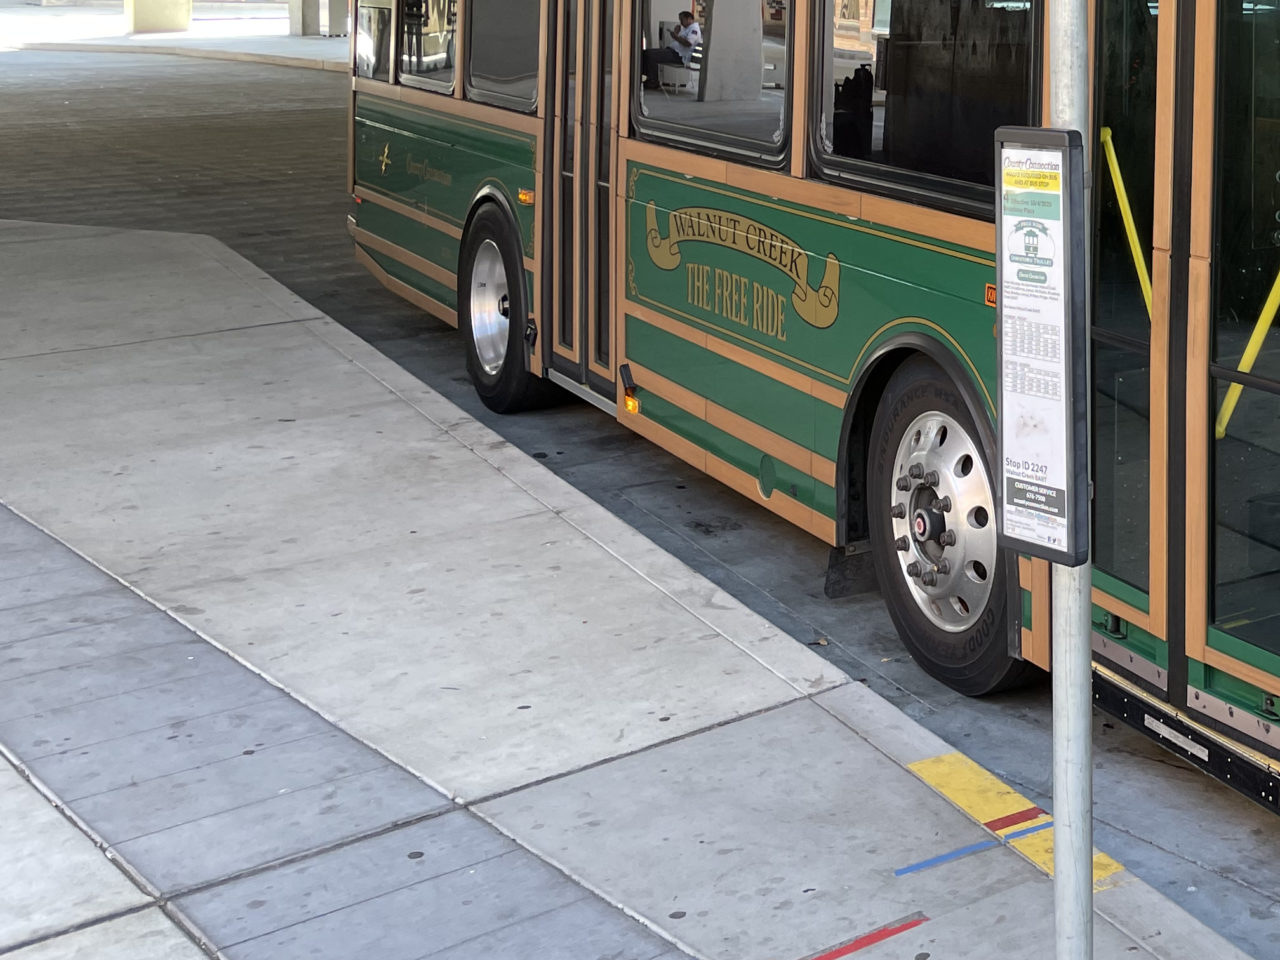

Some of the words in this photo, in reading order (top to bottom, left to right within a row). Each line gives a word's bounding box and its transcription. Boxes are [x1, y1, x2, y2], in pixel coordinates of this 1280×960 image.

[1025, 158, 1060, 171] Connection
[673, 212, 740, 245] WALNUT
[745, 224, 802, 280] CREEK
[686, 262, 710, 310] THE
[715, 268, 749, 326] FREE
[753, 283, 787, 342] RIDE
[1005, 457, 1021, 469] Stop
[1022, 461, 1030, 470] ID
[1031, 463, 1048, 474] 2247
[1006, 469, 1021, 477] Walnut
[1022, 472, 1034, 480] Creek
[1035, 474, 1047, 482] BART
[1015, 482, 1038, 492] CUSTOMER
[1039, 487, 1056, 497] SERVICE
